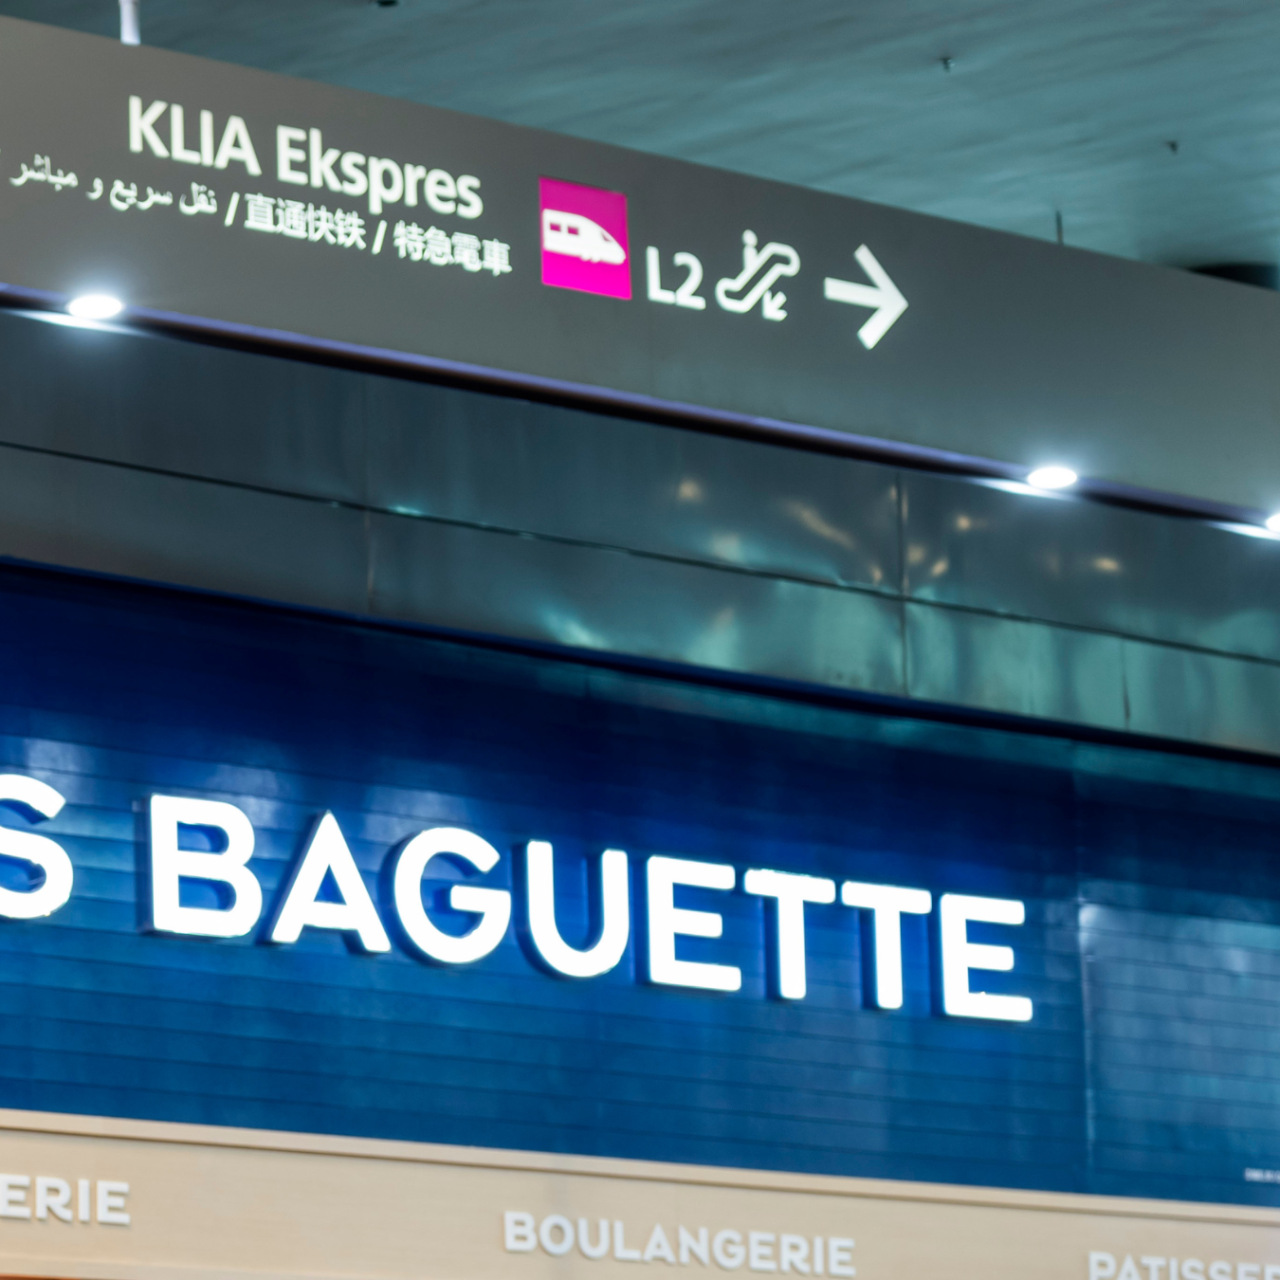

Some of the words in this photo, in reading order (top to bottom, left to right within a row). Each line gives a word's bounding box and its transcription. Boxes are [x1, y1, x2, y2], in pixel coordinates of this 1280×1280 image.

[9, 153, 79, 192] مباشر
[128, 95, 262, 176] KLIA
[276, 124, 484, 219] Ekspres
[109, 179, 173, 211] سريع
[179, 181, 218, 216] نقل
[244, 193, 366, 250] 直通快铁
[393, 220, 513, 276] 特急電車
[646, 245, 706, 310] L2
[144, 790, 1035, 1025] BAGUETTE
[503, 1210, 857, 1277] BOULANGERIE
